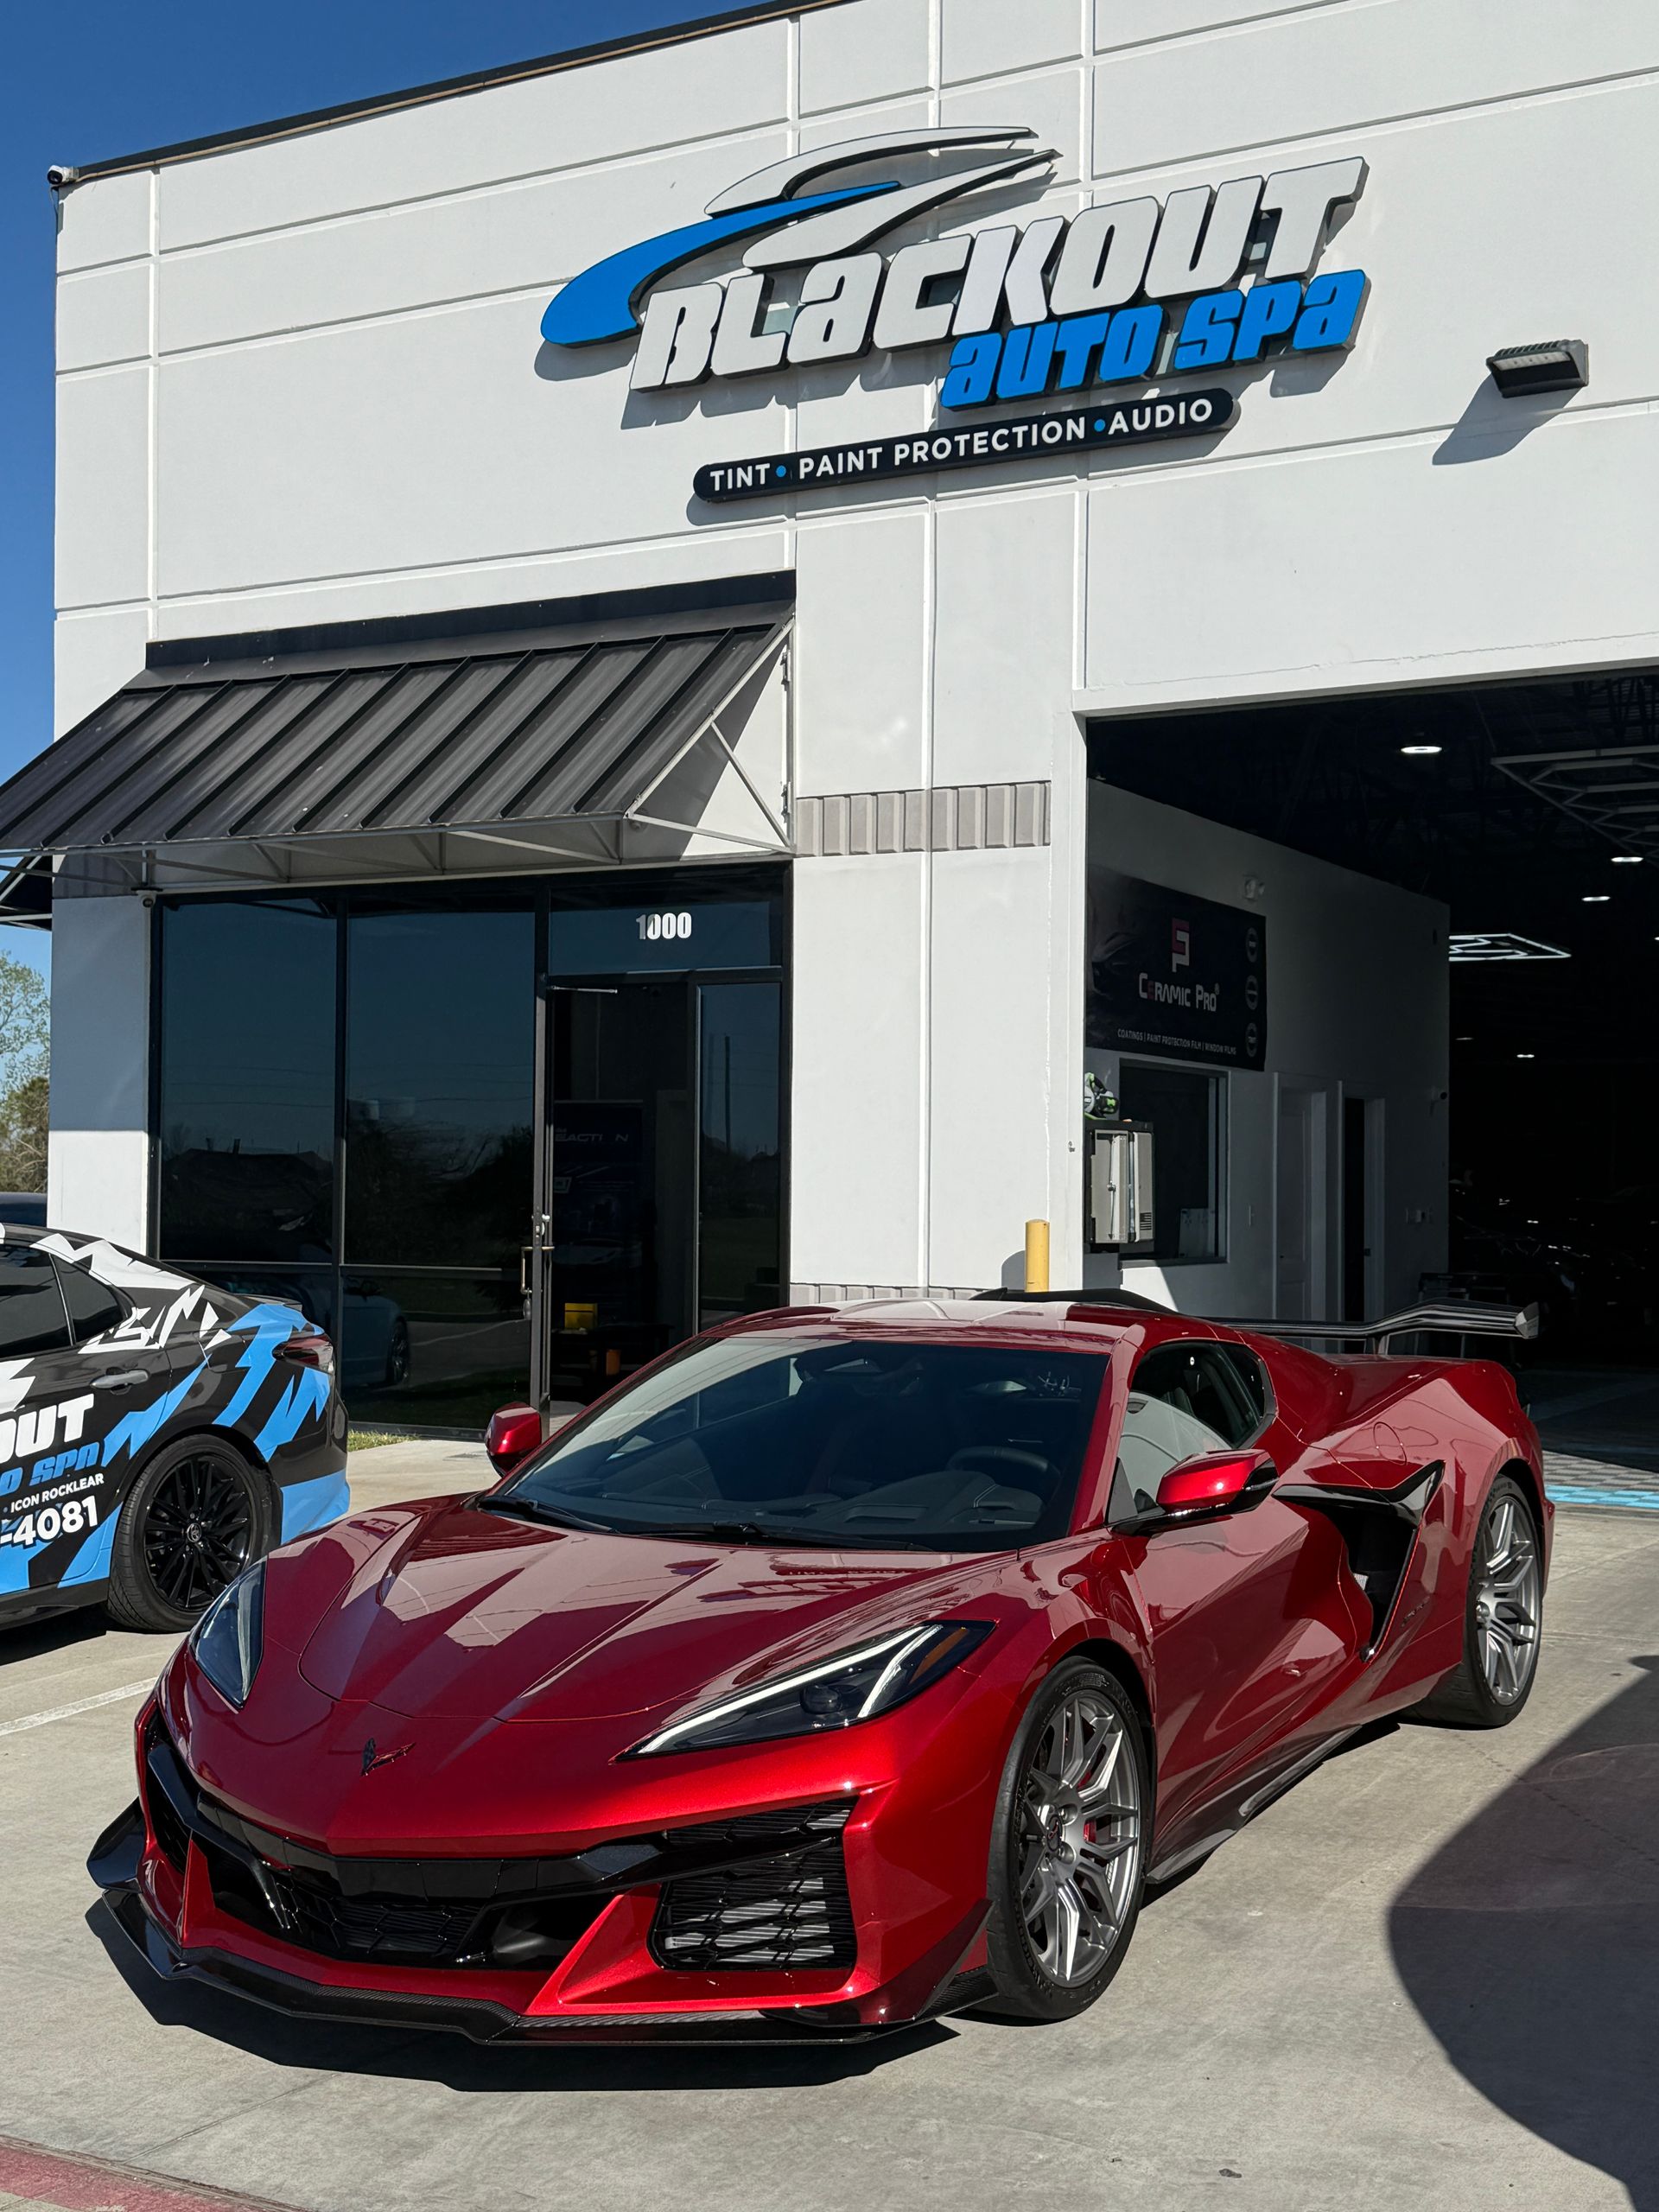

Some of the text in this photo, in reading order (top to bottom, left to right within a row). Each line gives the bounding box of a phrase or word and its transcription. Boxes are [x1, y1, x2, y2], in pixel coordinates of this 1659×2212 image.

[630, 156, 1367, 391] BLACKOUT
[940, 304, 1163, 410] AUTO
[710, 398, 1212, 492] TINT PAINT PROTECTION AUDIO
[636, 912, 691, 939] 1000
[1117, 1028, 1143, 1041] COATINGS
[1147, 1033, 1161, 1044] PAINT
[1162, 1035, 1191, 1047] PROTECTION
[1192, 1039, 1202, 1050] FILM
[10, 1472, 105, 1513] ICON ROCKLEAR
